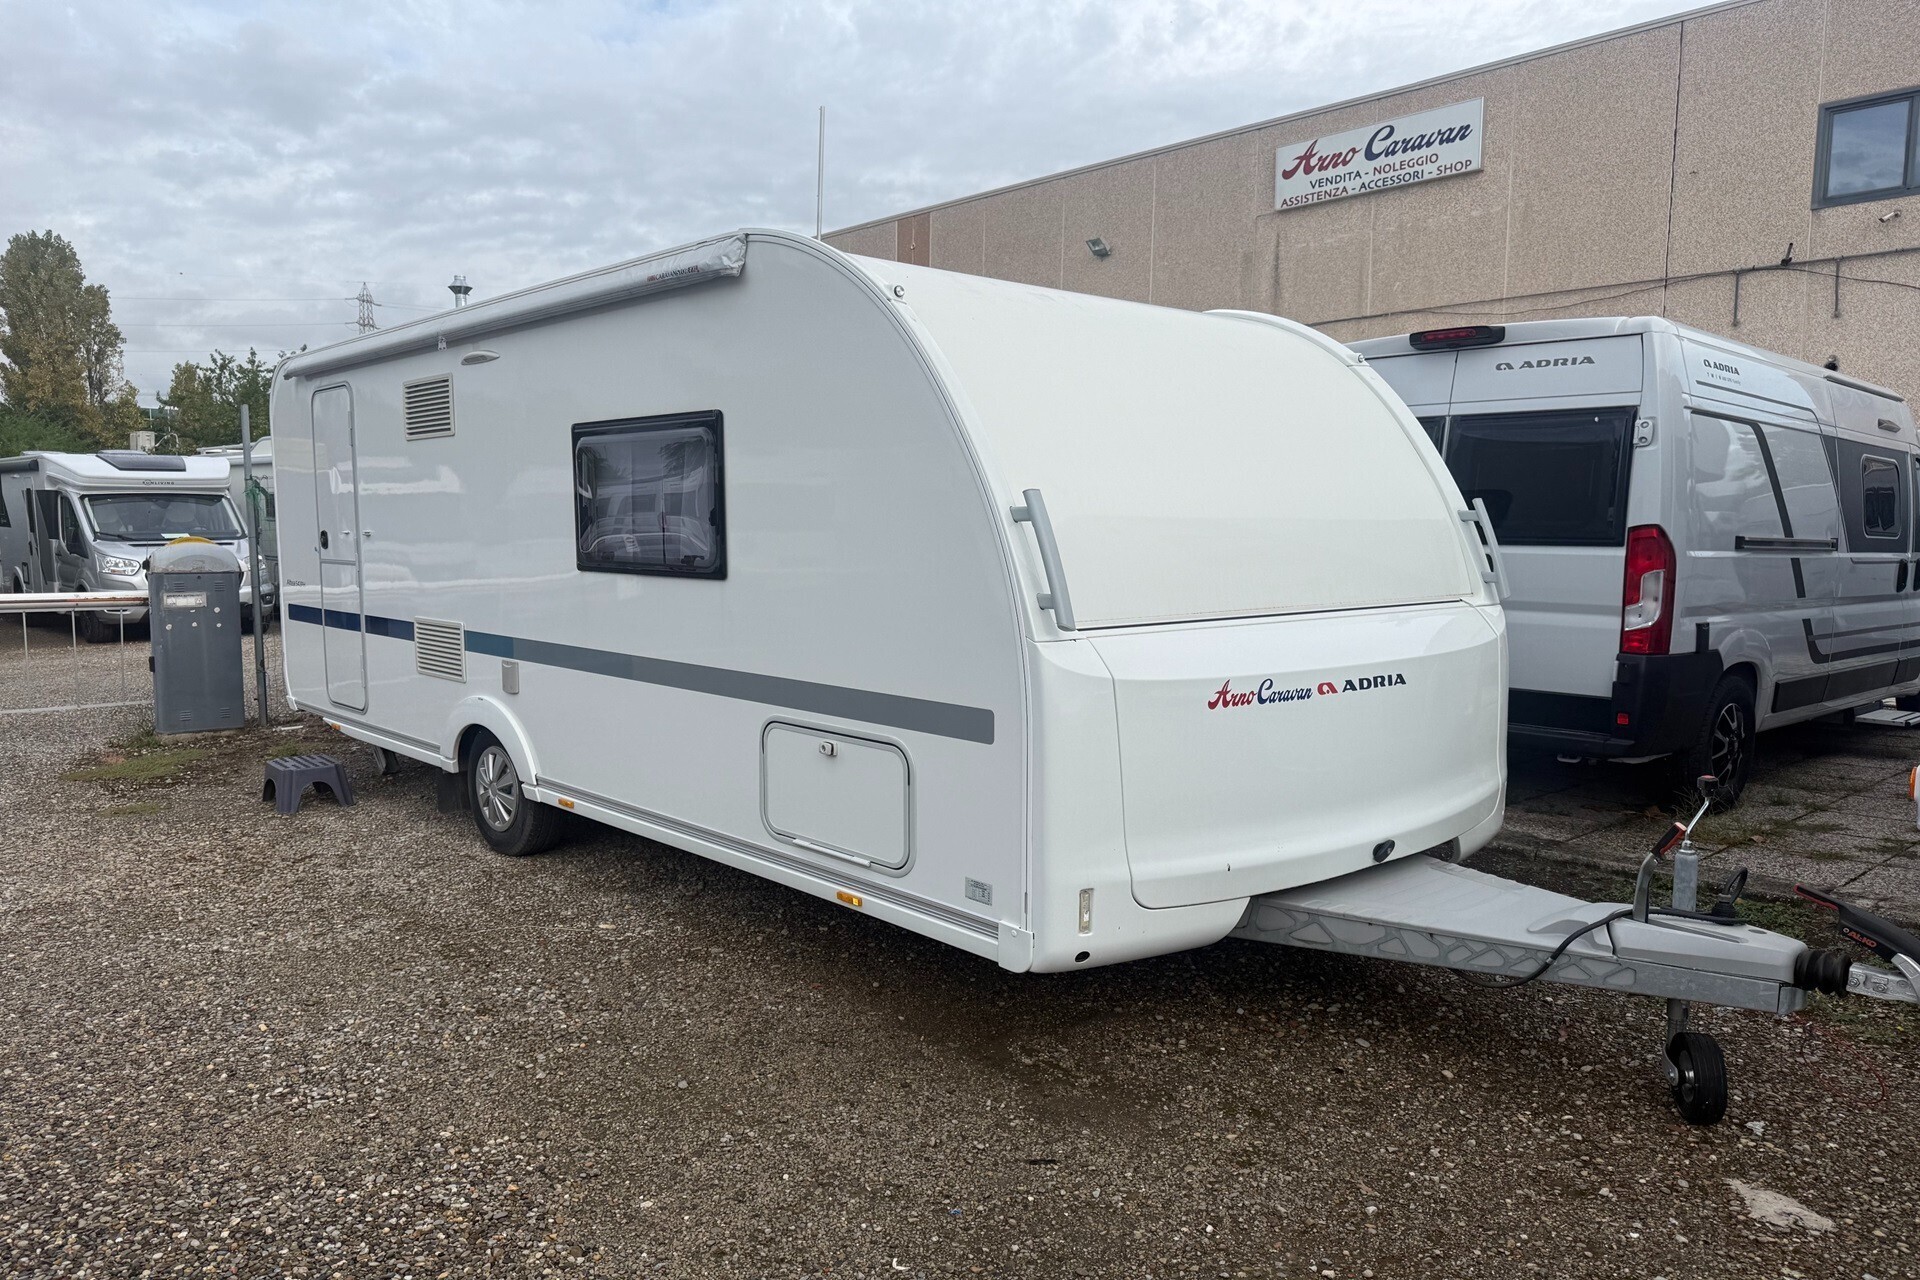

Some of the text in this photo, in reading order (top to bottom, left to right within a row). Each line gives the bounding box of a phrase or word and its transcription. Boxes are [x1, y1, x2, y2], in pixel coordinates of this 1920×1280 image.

[1282, 124, 1473, 180] Arno Caravan
[1280, 187, 1349, 208] ASSISTENZA
[1358, 170, 1424, 192] ACCESSORI
[1436, 159, 1472, 176] SHOP
[1309, 171, 1362, 190] VENDITA
[1373, 153, 1439, 177] NOLEGGIO
[1519, 356, 1595, 370] ADRIA
[1713, 361, 1740, 376] ADRIA
[1207, 673, 1406, 710] Arno Caravan ADRIA
